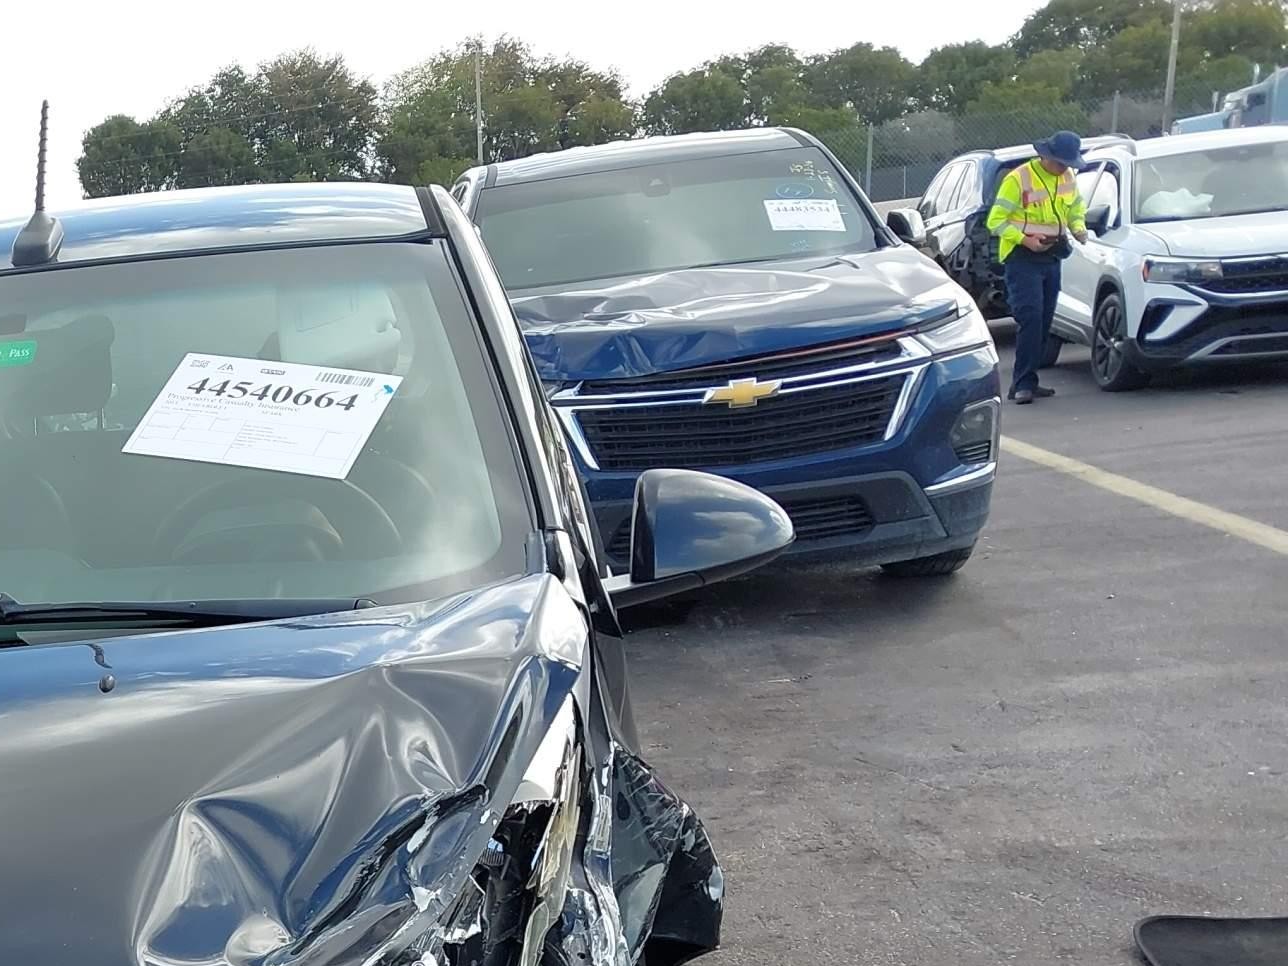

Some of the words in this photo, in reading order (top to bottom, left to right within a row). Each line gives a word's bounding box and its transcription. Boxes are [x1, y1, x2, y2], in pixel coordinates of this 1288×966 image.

[9, 348, 31, 358] PASS
[167, 392, 218, 403] Progressive
[218, 397, 255, 408] Casualty
[257, 401, 301, 413] Insurance
[187, 377, 359, 411] 44540664
